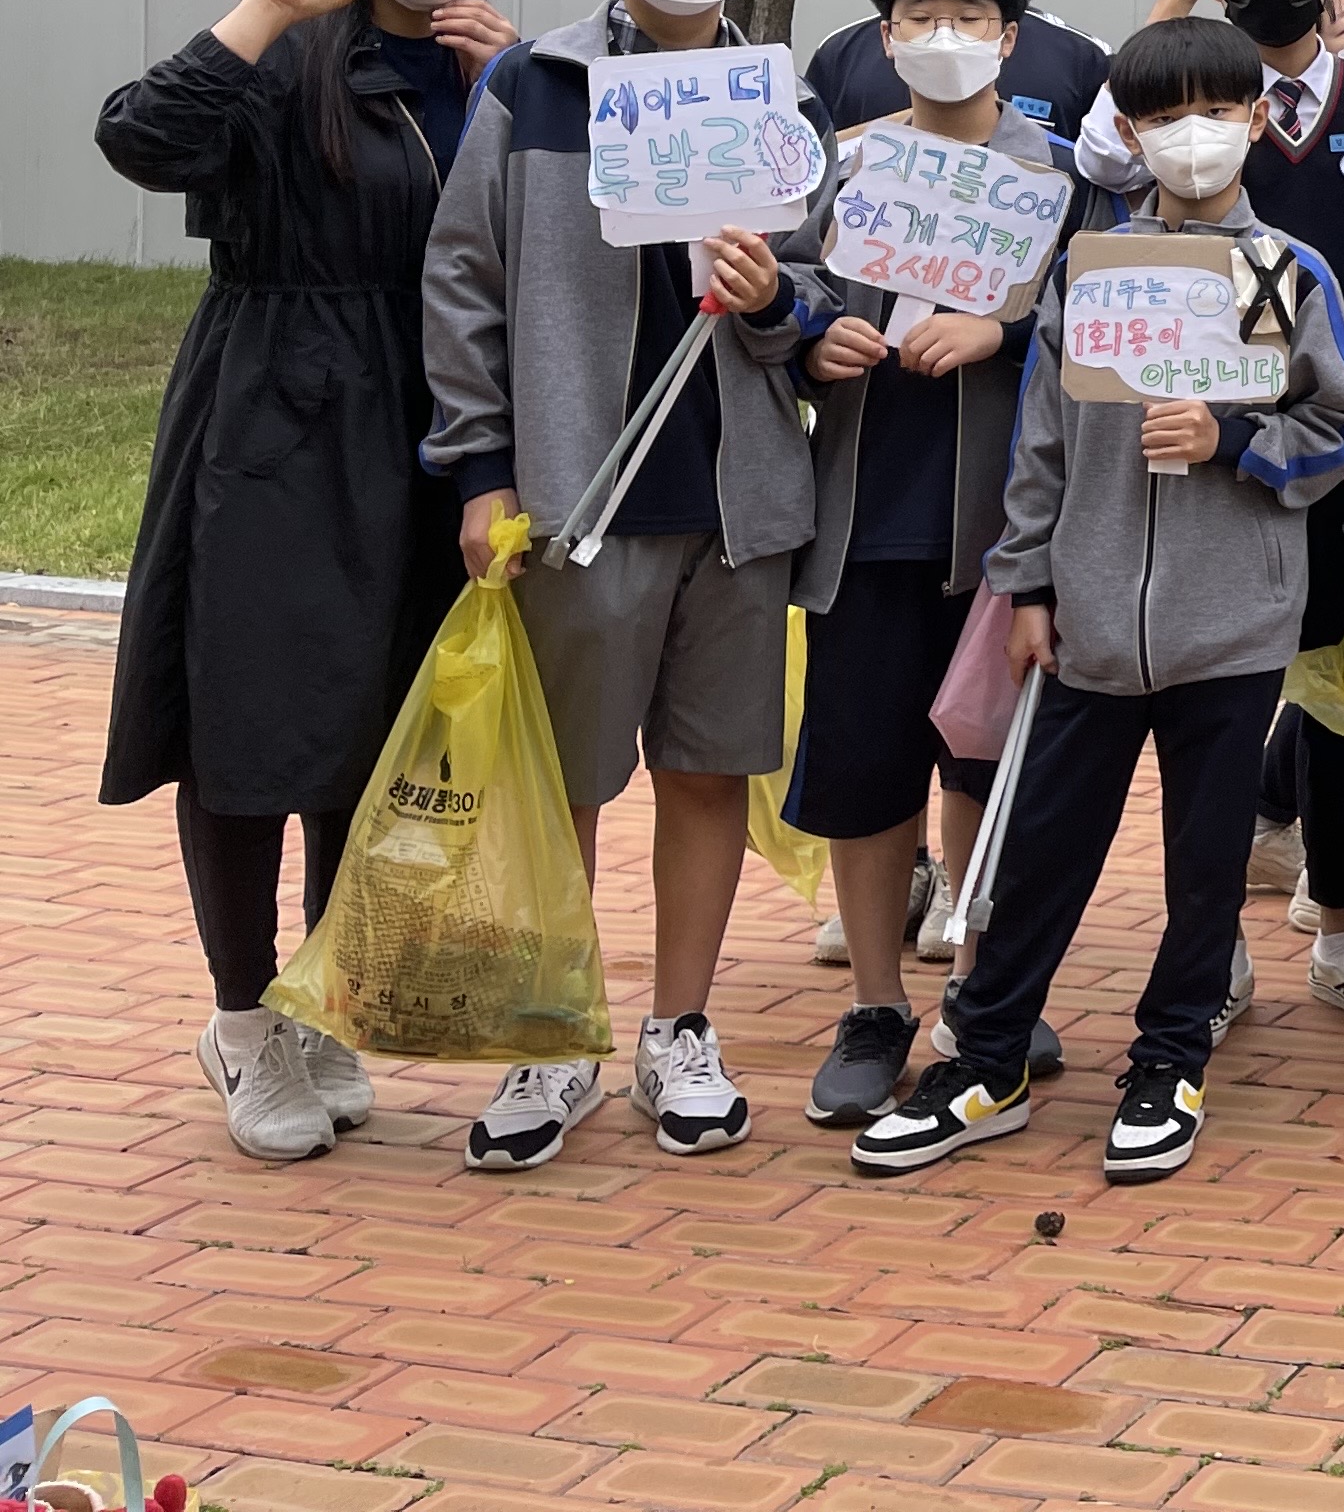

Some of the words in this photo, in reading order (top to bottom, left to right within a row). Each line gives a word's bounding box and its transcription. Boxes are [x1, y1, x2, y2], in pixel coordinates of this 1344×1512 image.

[595, 77, 710, 135] 세이브
[728, 58, 770, 105] 더
[590, 117, 755, 206] 투발루
[869, 133, 989, 204] 지구를
[839, 190, 939, 246] 하게
[860, 239, 1006, 303] 주세요!
[1072, 278, 1171, 310] 지구는
[1073, 318, 1183, 357] 1회용이
[1141, 353, 1285, 395] 아닙니다
